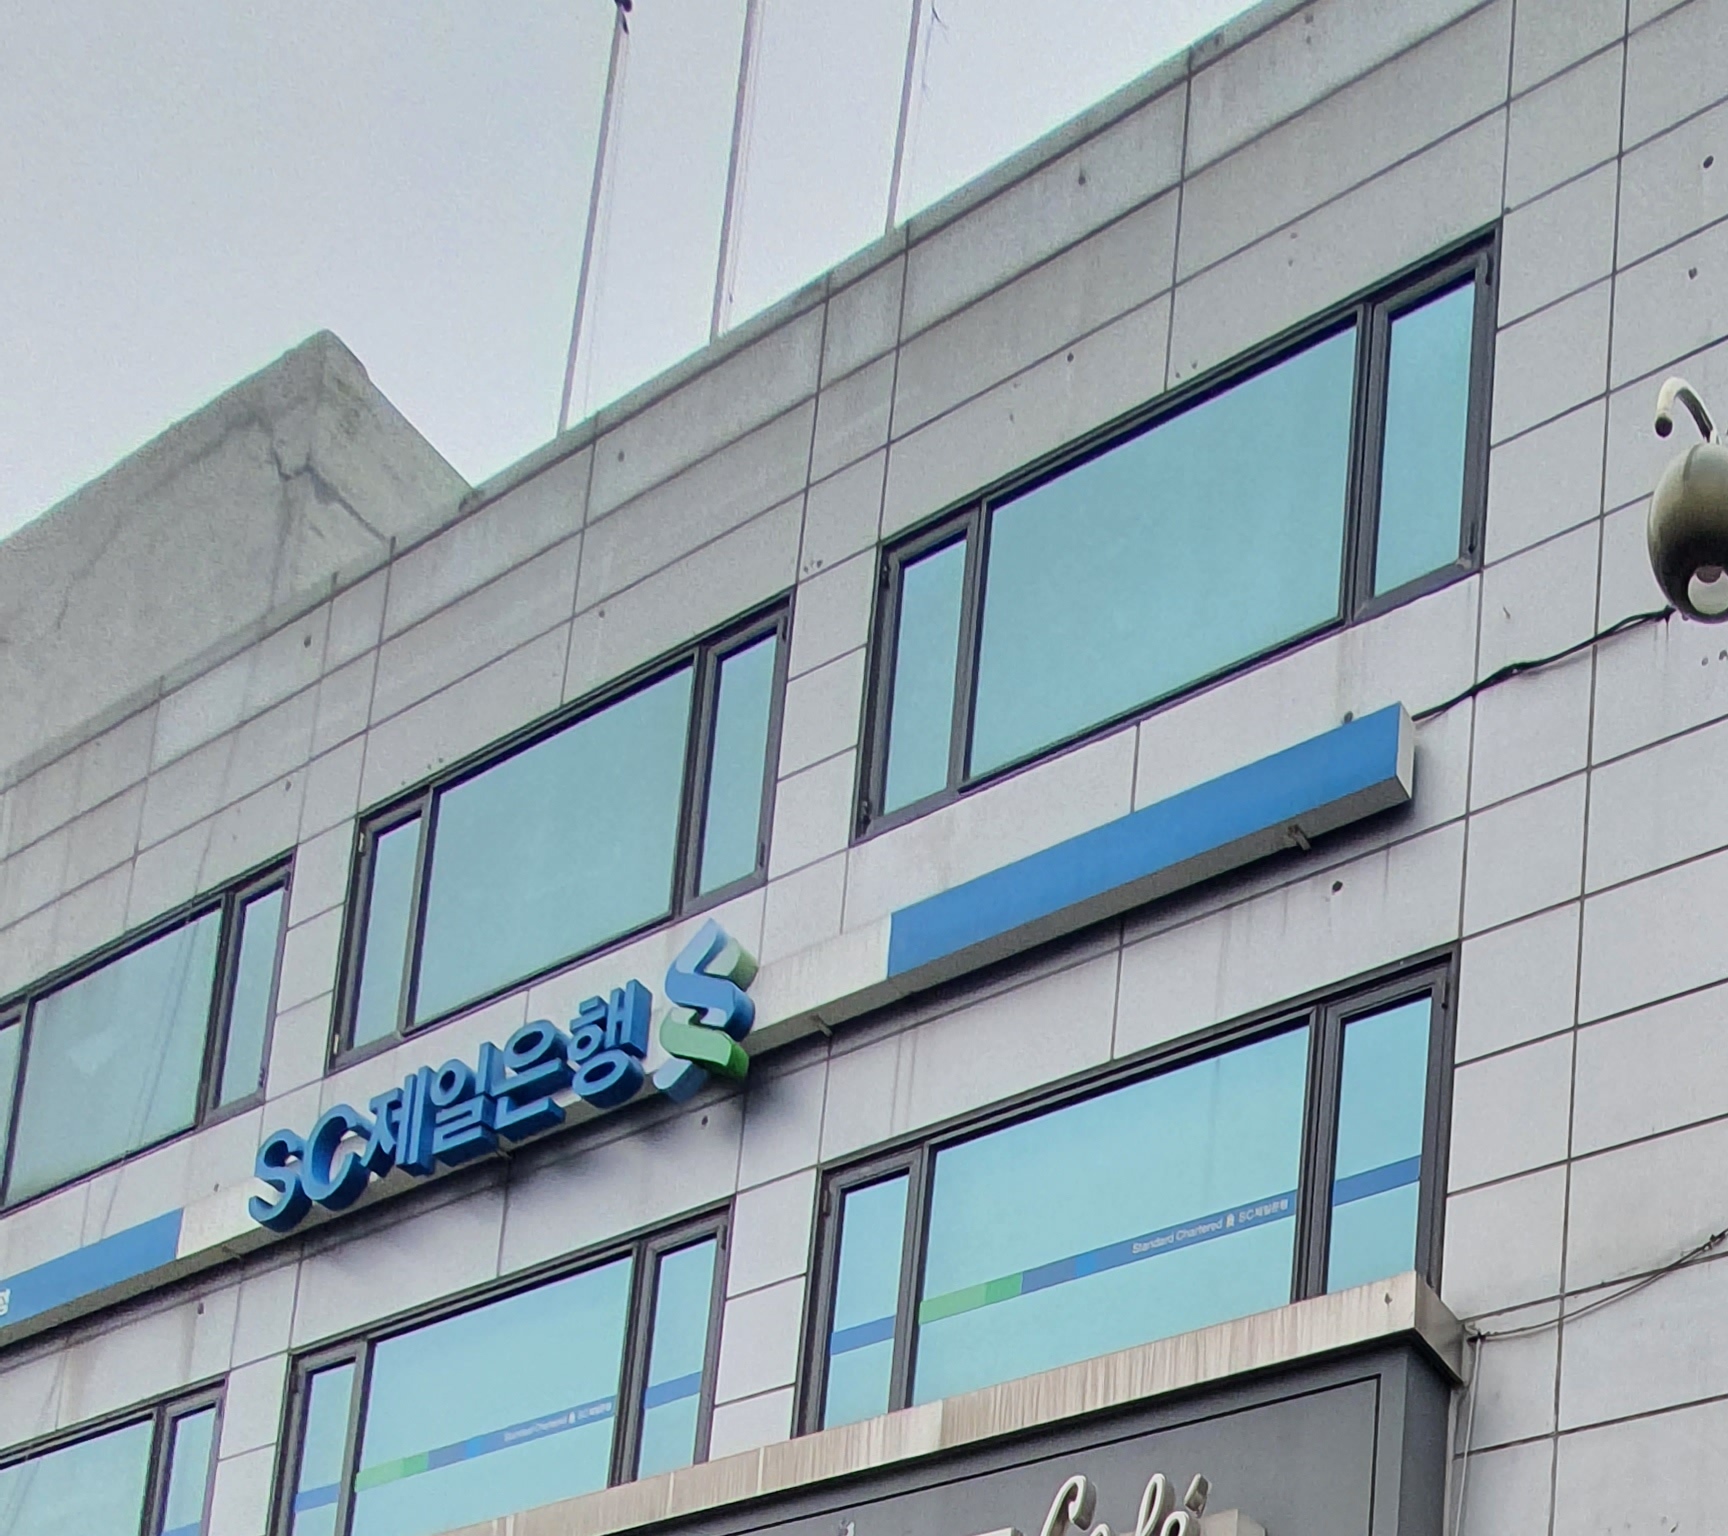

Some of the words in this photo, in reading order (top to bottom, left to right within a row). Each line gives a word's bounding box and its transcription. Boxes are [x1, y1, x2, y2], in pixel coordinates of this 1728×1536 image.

[248, 978, 653, 1233] SC제일은행
[1132, 1234, 1175, 1254] Standard
[1176, 1218, 1223, 1241] Chartered
